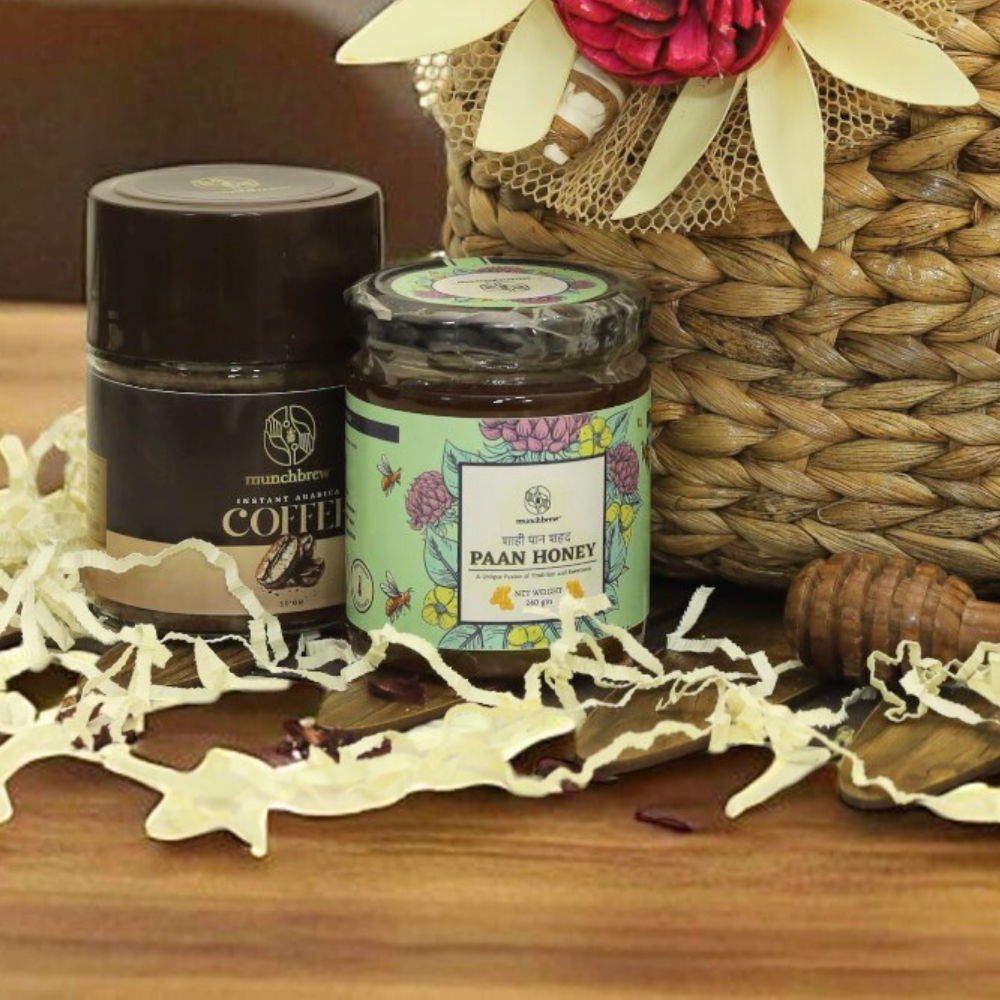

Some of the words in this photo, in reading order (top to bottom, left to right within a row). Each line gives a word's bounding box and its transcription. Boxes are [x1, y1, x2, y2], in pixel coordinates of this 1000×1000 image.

[244, 468, 330, 487] munchbrew
[236, 495, 289, 504] INSTANT
[528, 534, 547, 545] पान
[548, 531, 572, 544] शहद
[470, 550, 526, 566] PAAN
[532, 542, 597, 564] HONEY
[514, 589, 531, 597] NET
